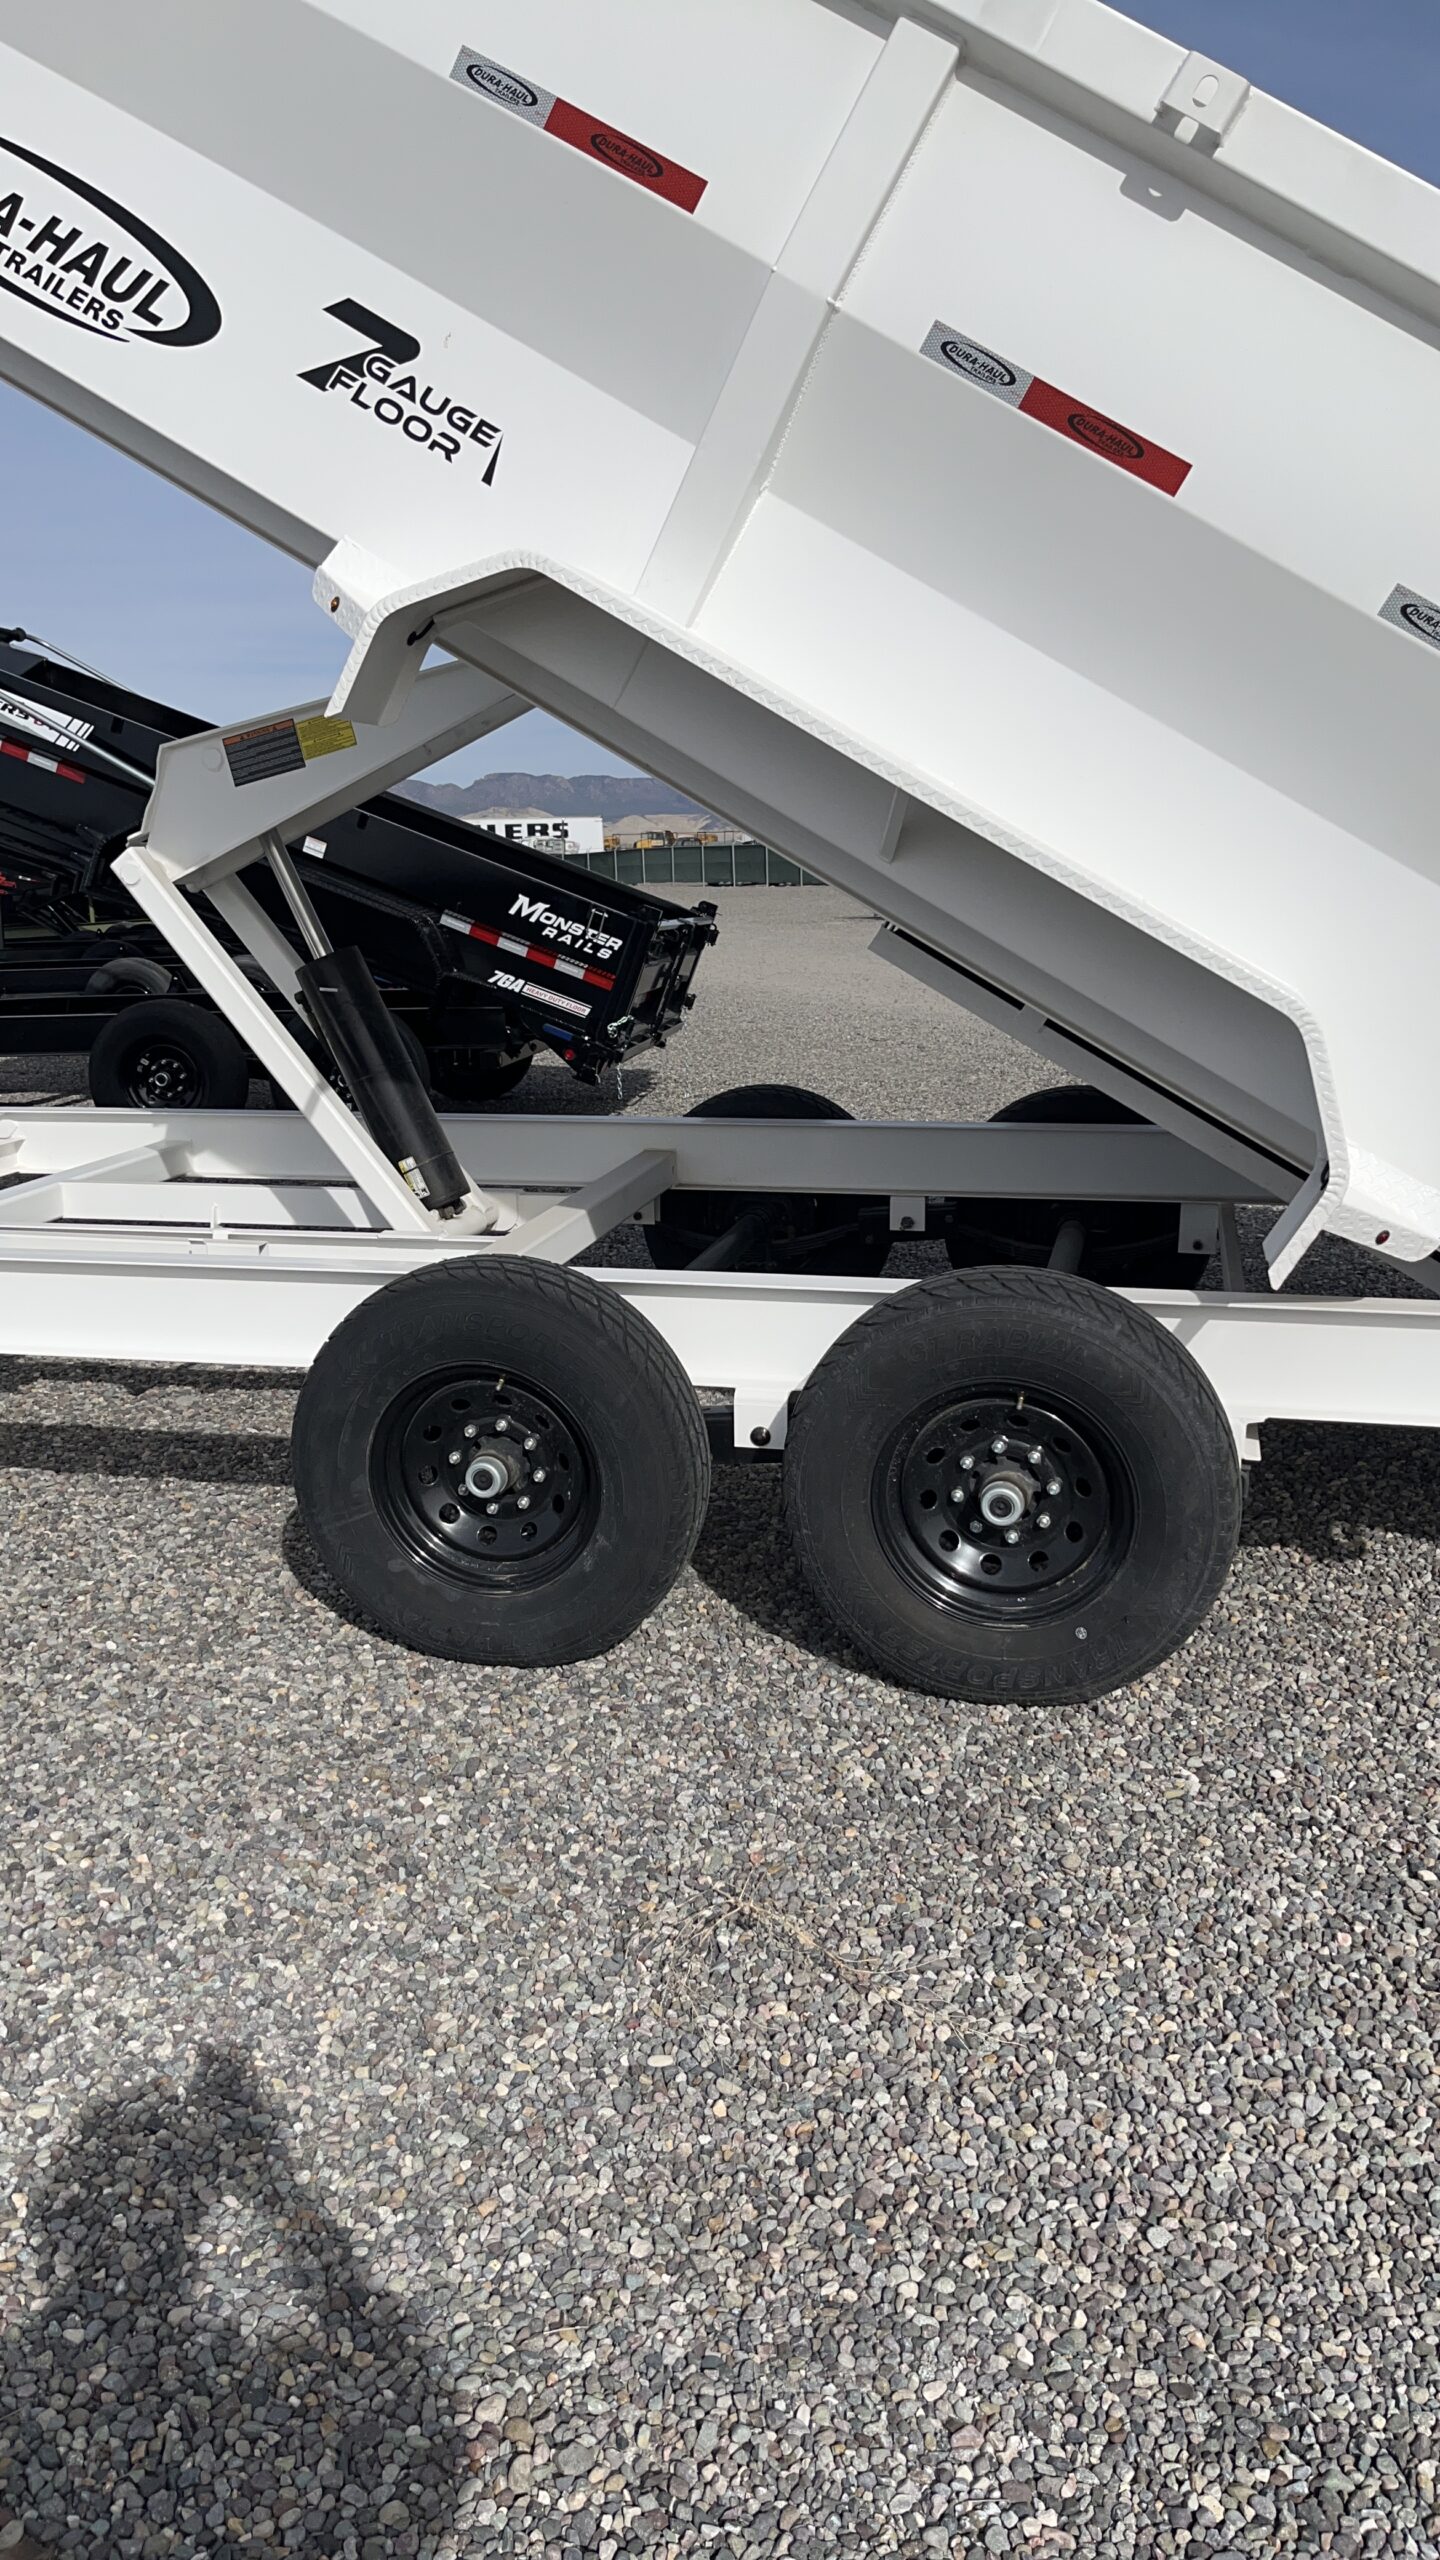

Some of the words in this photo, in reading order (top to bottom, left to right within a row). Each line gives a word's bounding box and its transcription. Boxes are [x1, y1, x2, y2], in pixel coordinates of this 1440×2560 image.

[474, 67, 530, 104] DURA-HAUL
[598, 136, 654, 174] DURA-HAUL
[948, 344, 1008, 383] DURA-HAUL
[327, 367, 462, 464] FLOOR
[364, 354, 503, 449] GAUGE
[1075, 417, 1134, 456] DURA-HAUL
[508, 893, 624, 951] MONSTER
[541, 926, 613, 960] RAILS
[487, 969, 526, 993] 7GA
[526, 986, 548, 998] HEAVY
[547, 995, 566, 1005] DUTY
[565, 1002, 587, 1013] FLOOR
